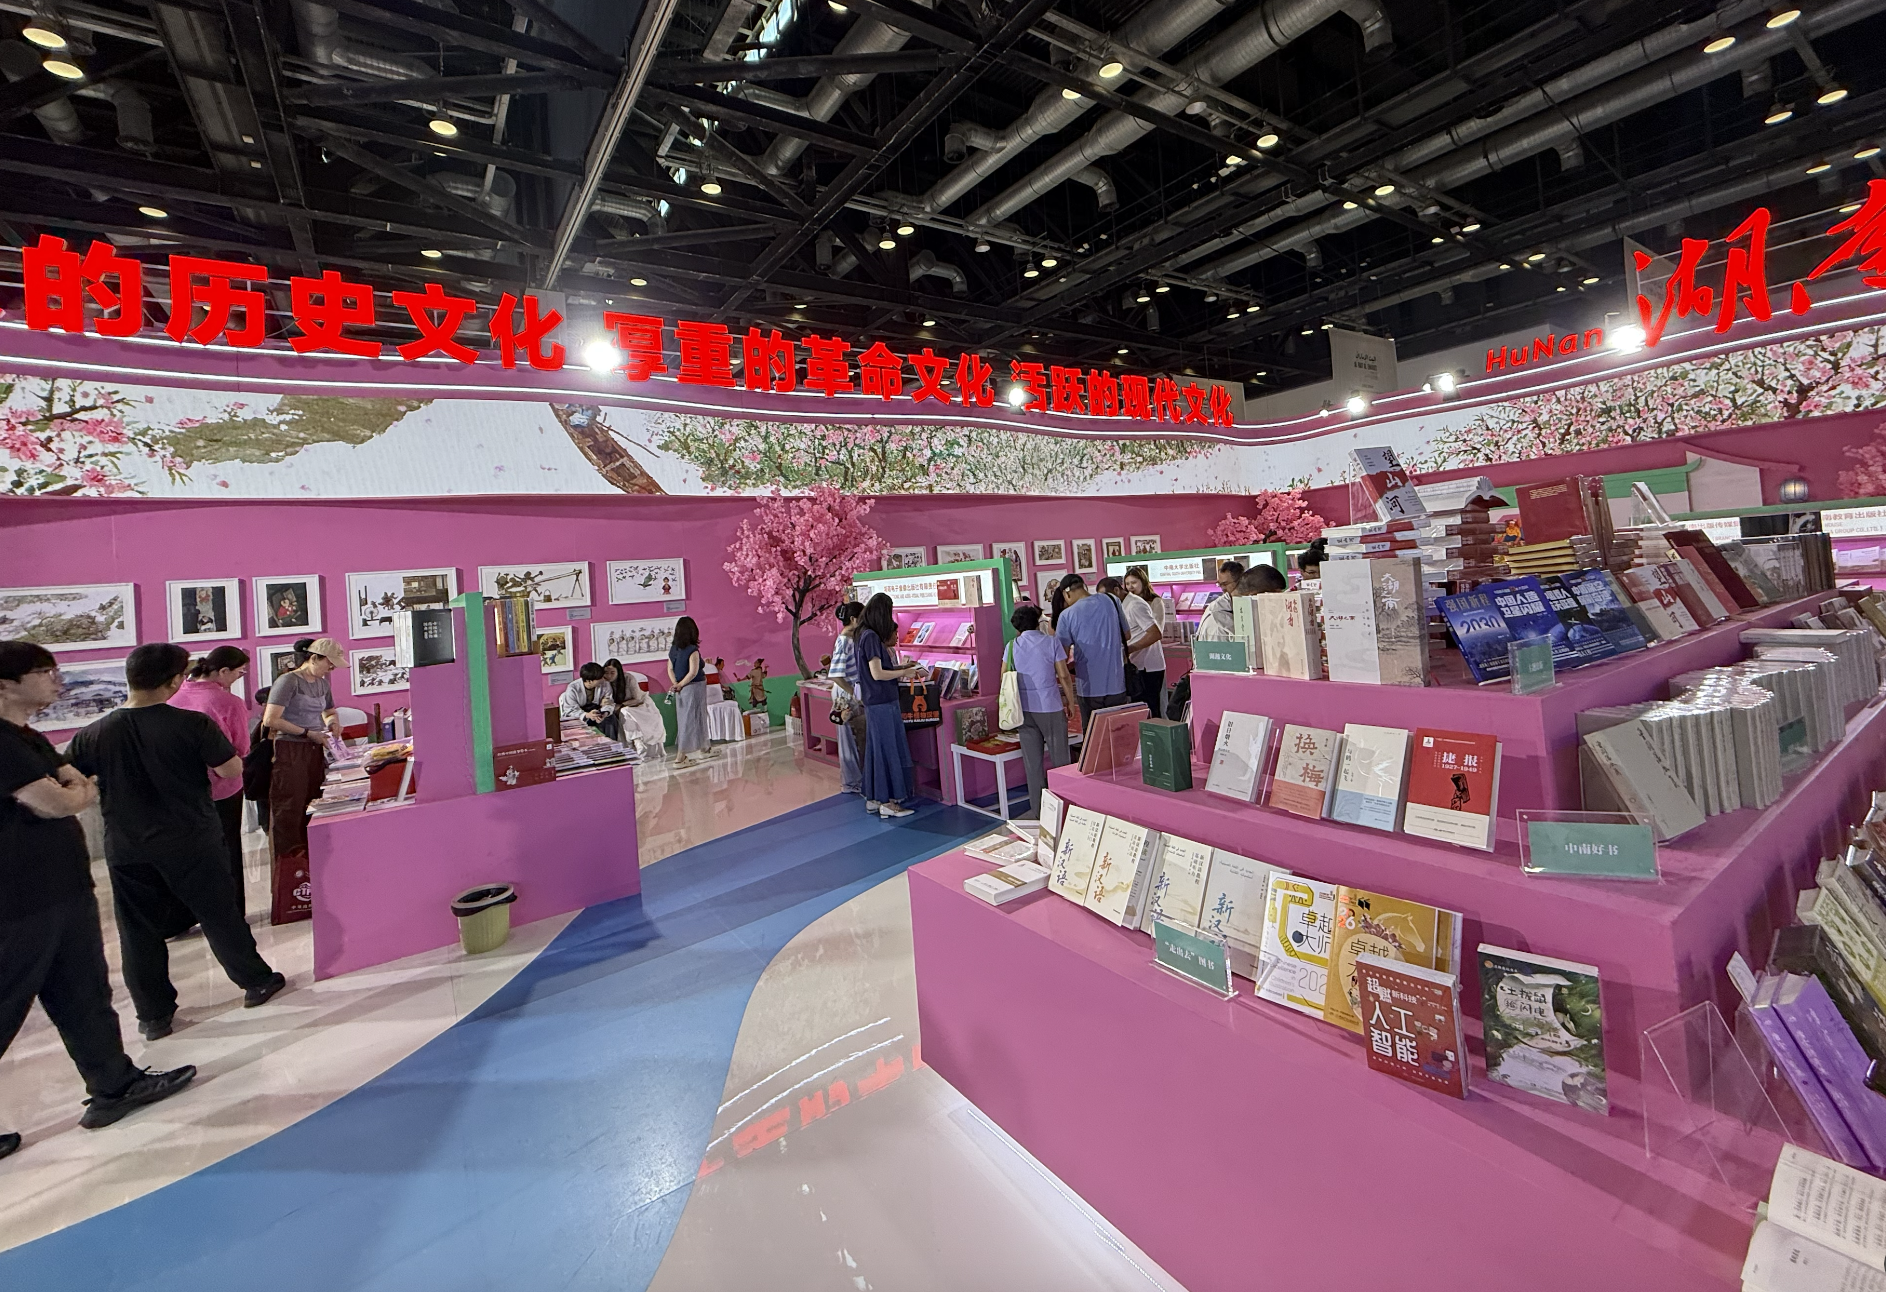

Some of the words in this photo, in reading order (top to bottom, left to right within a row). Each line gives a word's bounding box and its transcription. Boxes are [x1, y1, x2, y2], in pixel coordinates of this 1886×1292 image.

[22, 234, 567, 371] 的历史文化
[602, 311, 995, 408] 厚重的革命文化
[1010, 359, 1234, 428] 活跃的现代文化
[1486, 328, 1603, 372] HuNan
[1382, 448, 1405, 515] 望山河
[1494, 590, 1540, 607] 中国人造
[1460, 614, 1501, 634] 2030
[1442, 752, 1478, 766] 捷报
[1056, 838, 1074, 886] 新汉语
[1565, 842, 1619, 856] 中南好书
[1094, 852, 1112, 903] 新汉语
[1506, 987, 1547, 1004] 土拨鼠
[1369, 1001, 1416, 1038] 人工
[1370, 1026, 1420, 1066] 智能
